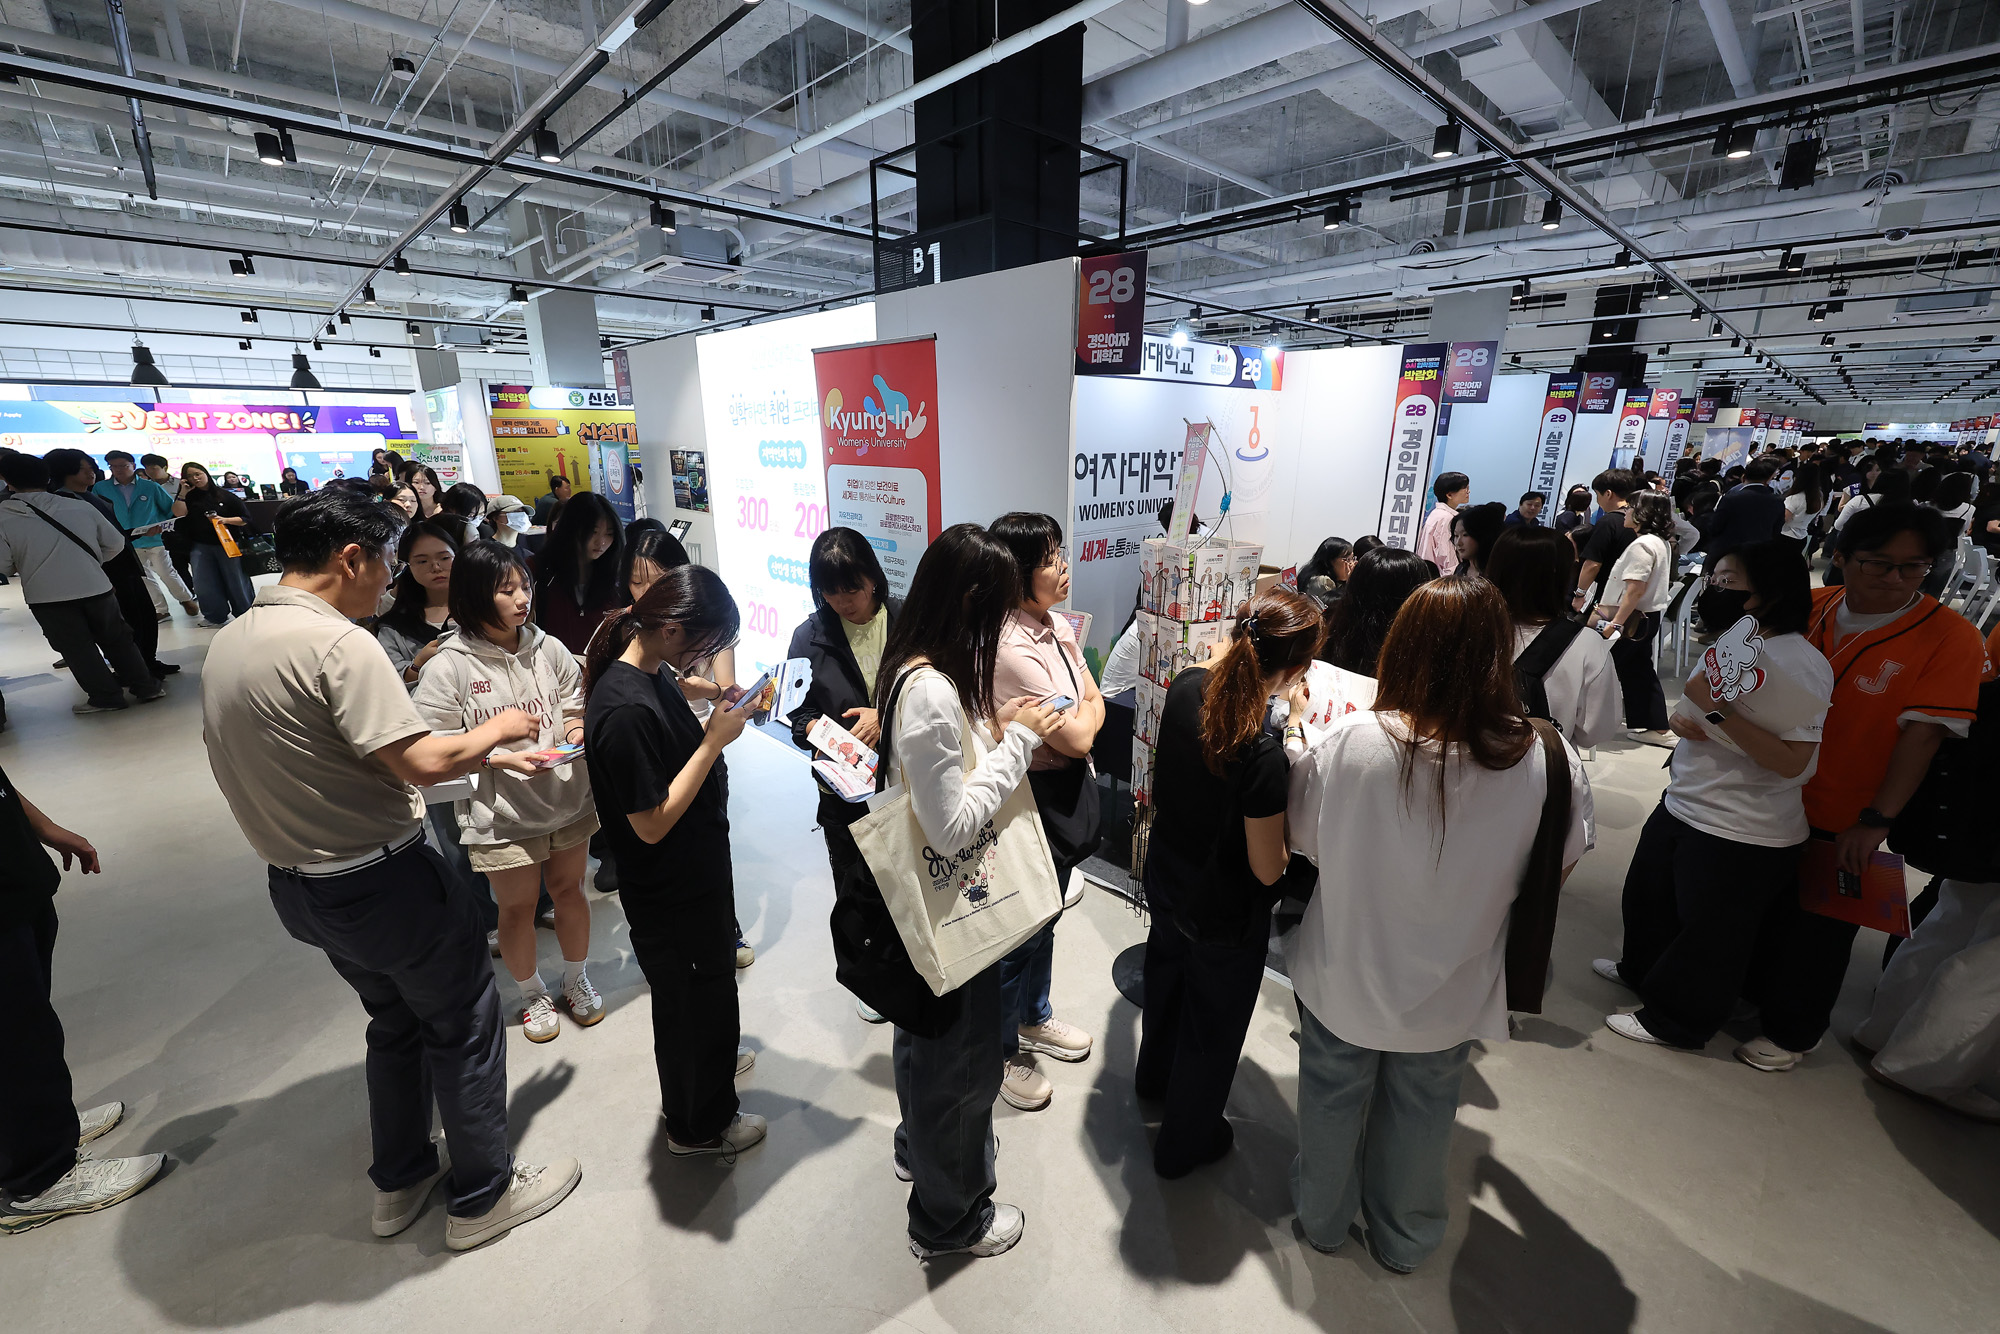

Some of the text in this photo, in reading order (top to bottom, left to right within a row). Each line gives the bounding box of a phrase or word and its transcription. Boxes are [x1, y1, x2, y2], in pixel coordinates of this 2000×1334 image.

[913, 241, 941, 284] B1
[1088, 267, 1135, 305] 28
[1088, 332, 1130, 349] 경인여자
[1091, 349, 1123, 364] 대학교
[1143, 342, 1194, 374] 대학교
[1456, 348, 1489, 367] 28
[616, 356, 628, 373] 19
[1241, 357, 1262, 381] 28
[1404, 369, 1438, 382] 박람회
[1452, 381, 1482, 390] 경인여자
[1589, 377, 1615, 390] 29
[498, 392, 529, 403] 박람회
[588, 392, 617, 407] 신성
[1454, 389, 1477, 398] 대학교
[1550, 390, 1576, 399] 박람회
[1657, 392, 1677, 401] 30
[729, 399, 767, 426] 입학하면
[769, 397, 790, 425] 취업
[1405, 404, 1427, 416] 28
[1700, 401, 1715, 409] 31
[102, 410, 302, 431] EVENT ZONE!
[829, 403, 914, 438] Kyung-In
[1550, 414, 1567, 422] 29
[495, 426, 511, 435] 결국
[577, 422, 639, 446] 신성대
[2, 433, 23, 446] 01
[151, 435, 171, 445] 02
[837, 437, 907, 451] Women's University
[426, 455, 461, 463] 신성대학교
[1075, 449, 1184, 498] 여자대학
[846, 479, 899, 492] 취업에 강한 보건의료
[841, 490, 906, 506] 세계로 통하는 K-Culture
[737, 495, 769, 532] 300
[1079, 500, 1135, 522] WOMEN'S
[748, 600, 778, 638] 200
[1853, 659, 1905, 695] J
[470, 680, 492, 695] 1983
